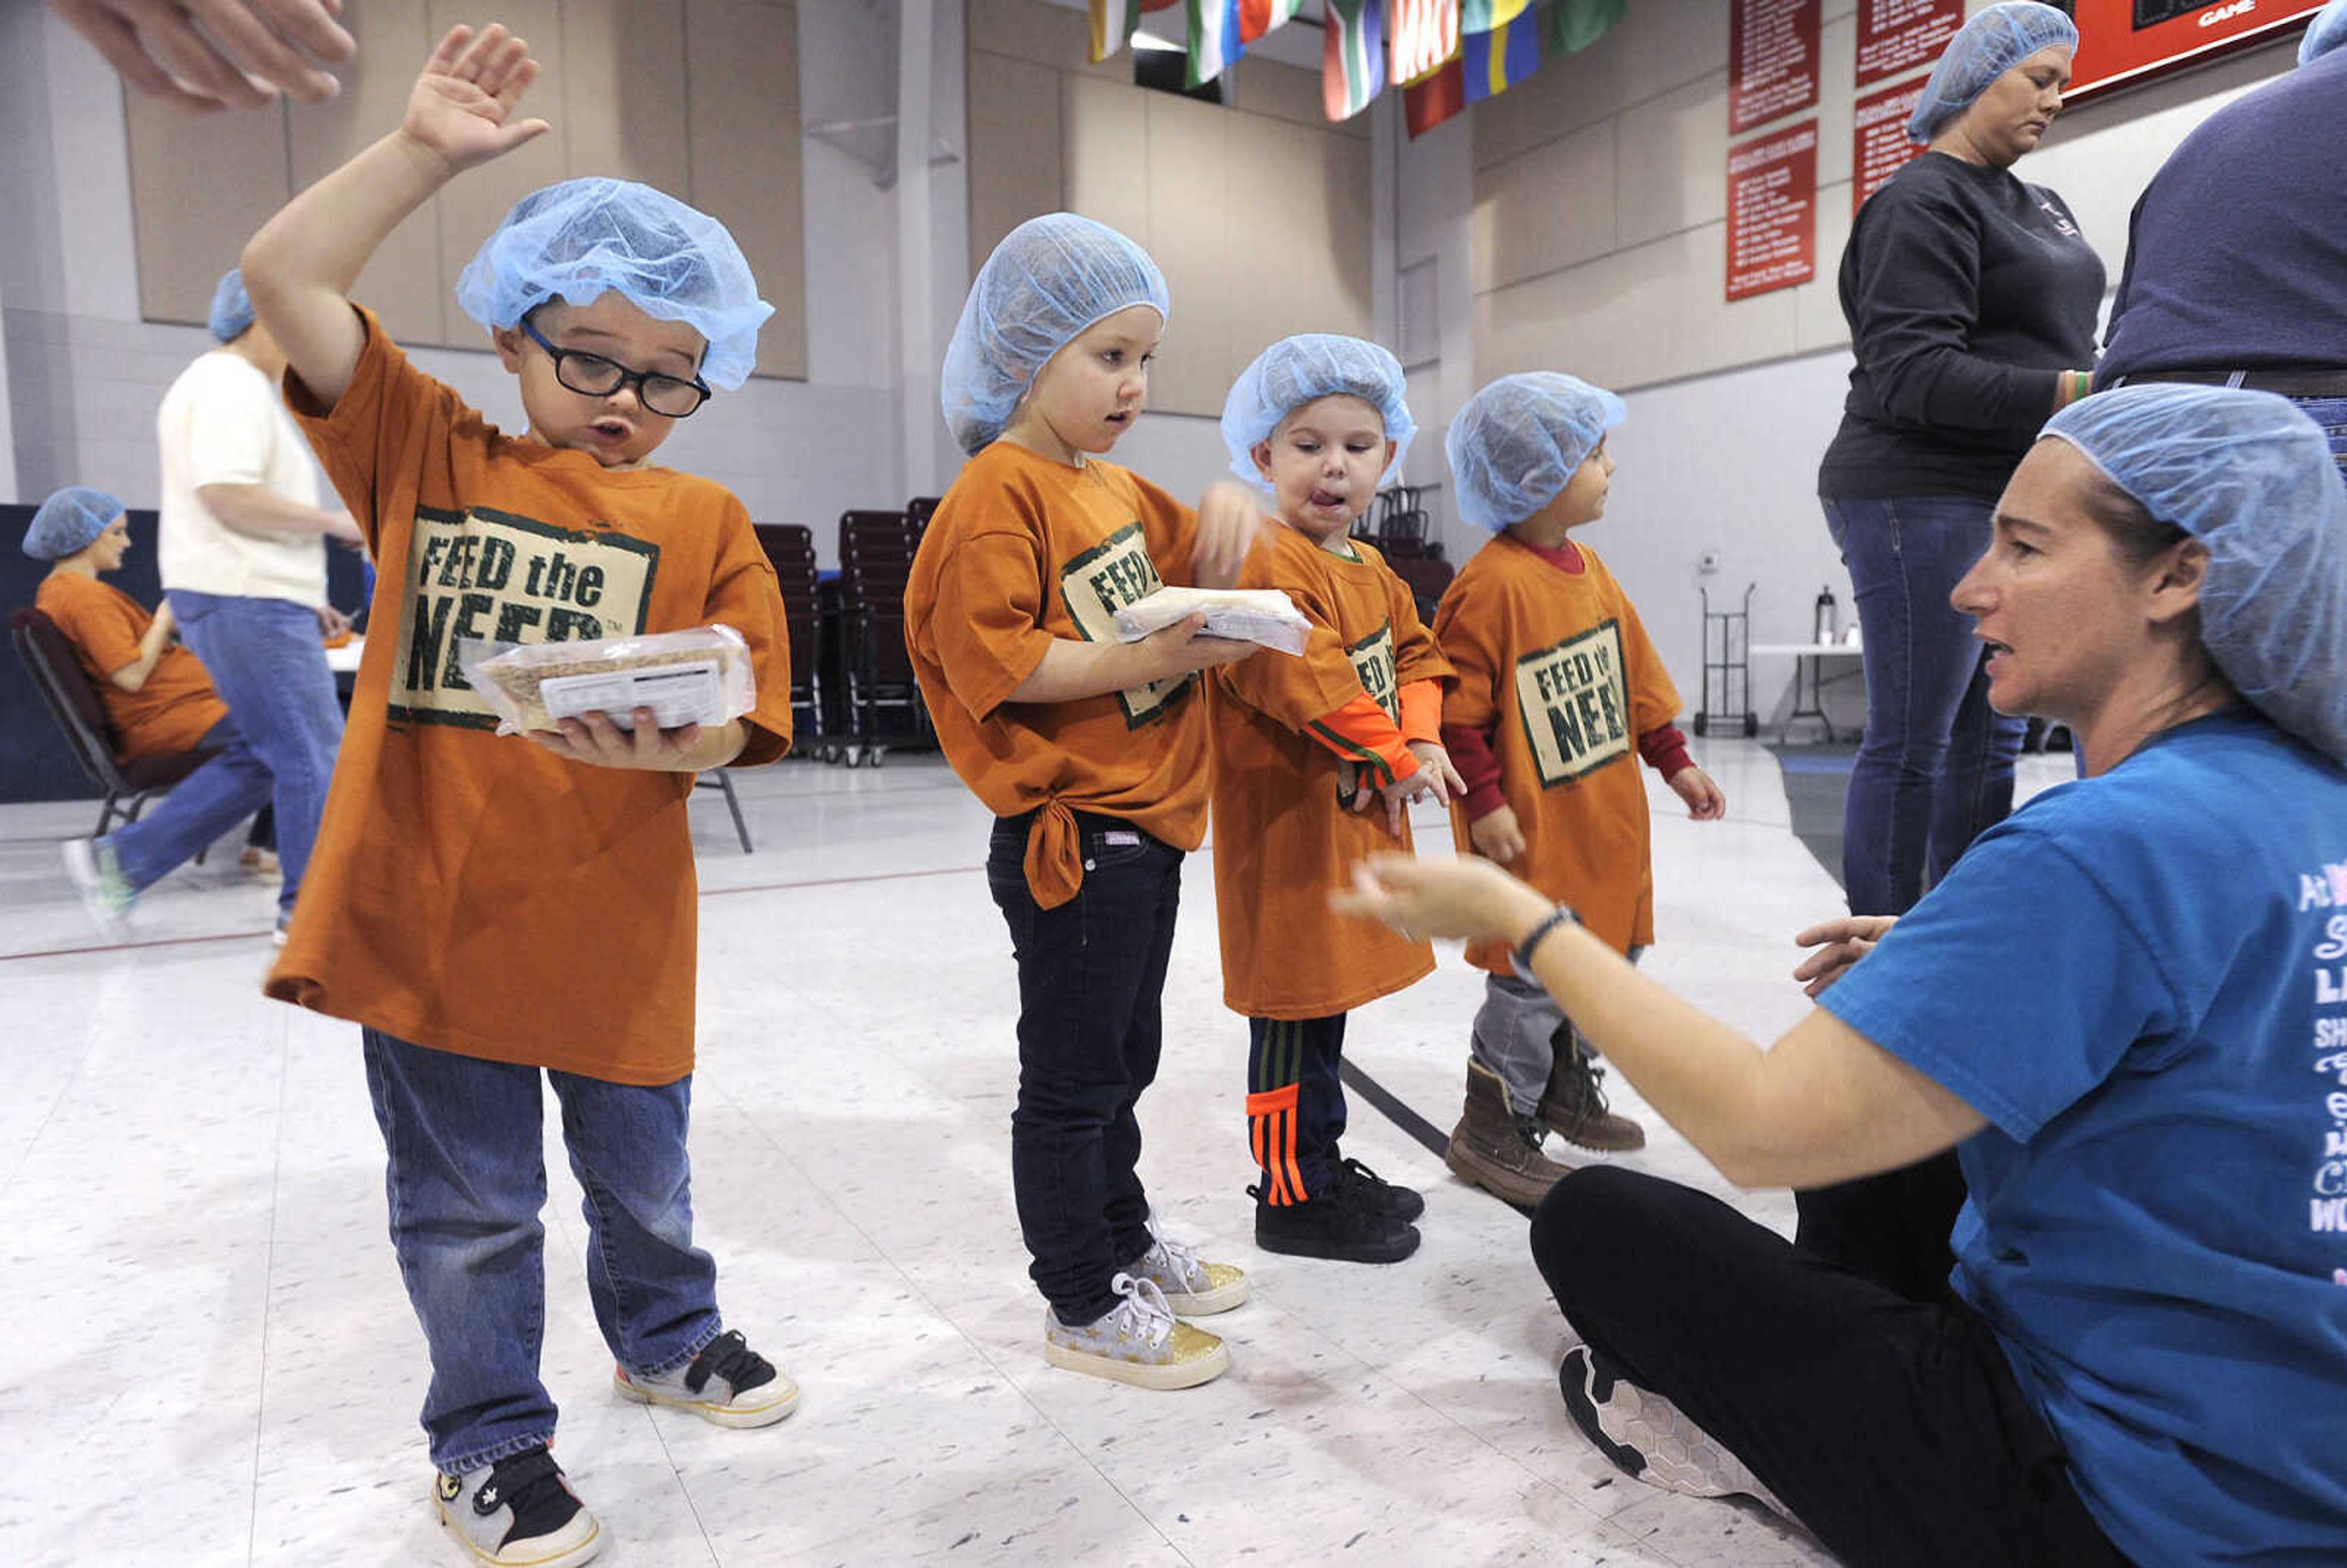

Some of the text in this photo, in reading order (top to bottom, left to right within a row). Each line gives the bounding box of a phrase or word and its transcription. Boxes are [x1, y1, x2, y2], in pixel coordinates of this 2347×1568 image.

[2198, 0, 2256, 26] GAME
[420, 535, 605, 607] FEED the
[1089, 550, 1148, 617] FEED
[1535, 652, 1594, 703] FEED
